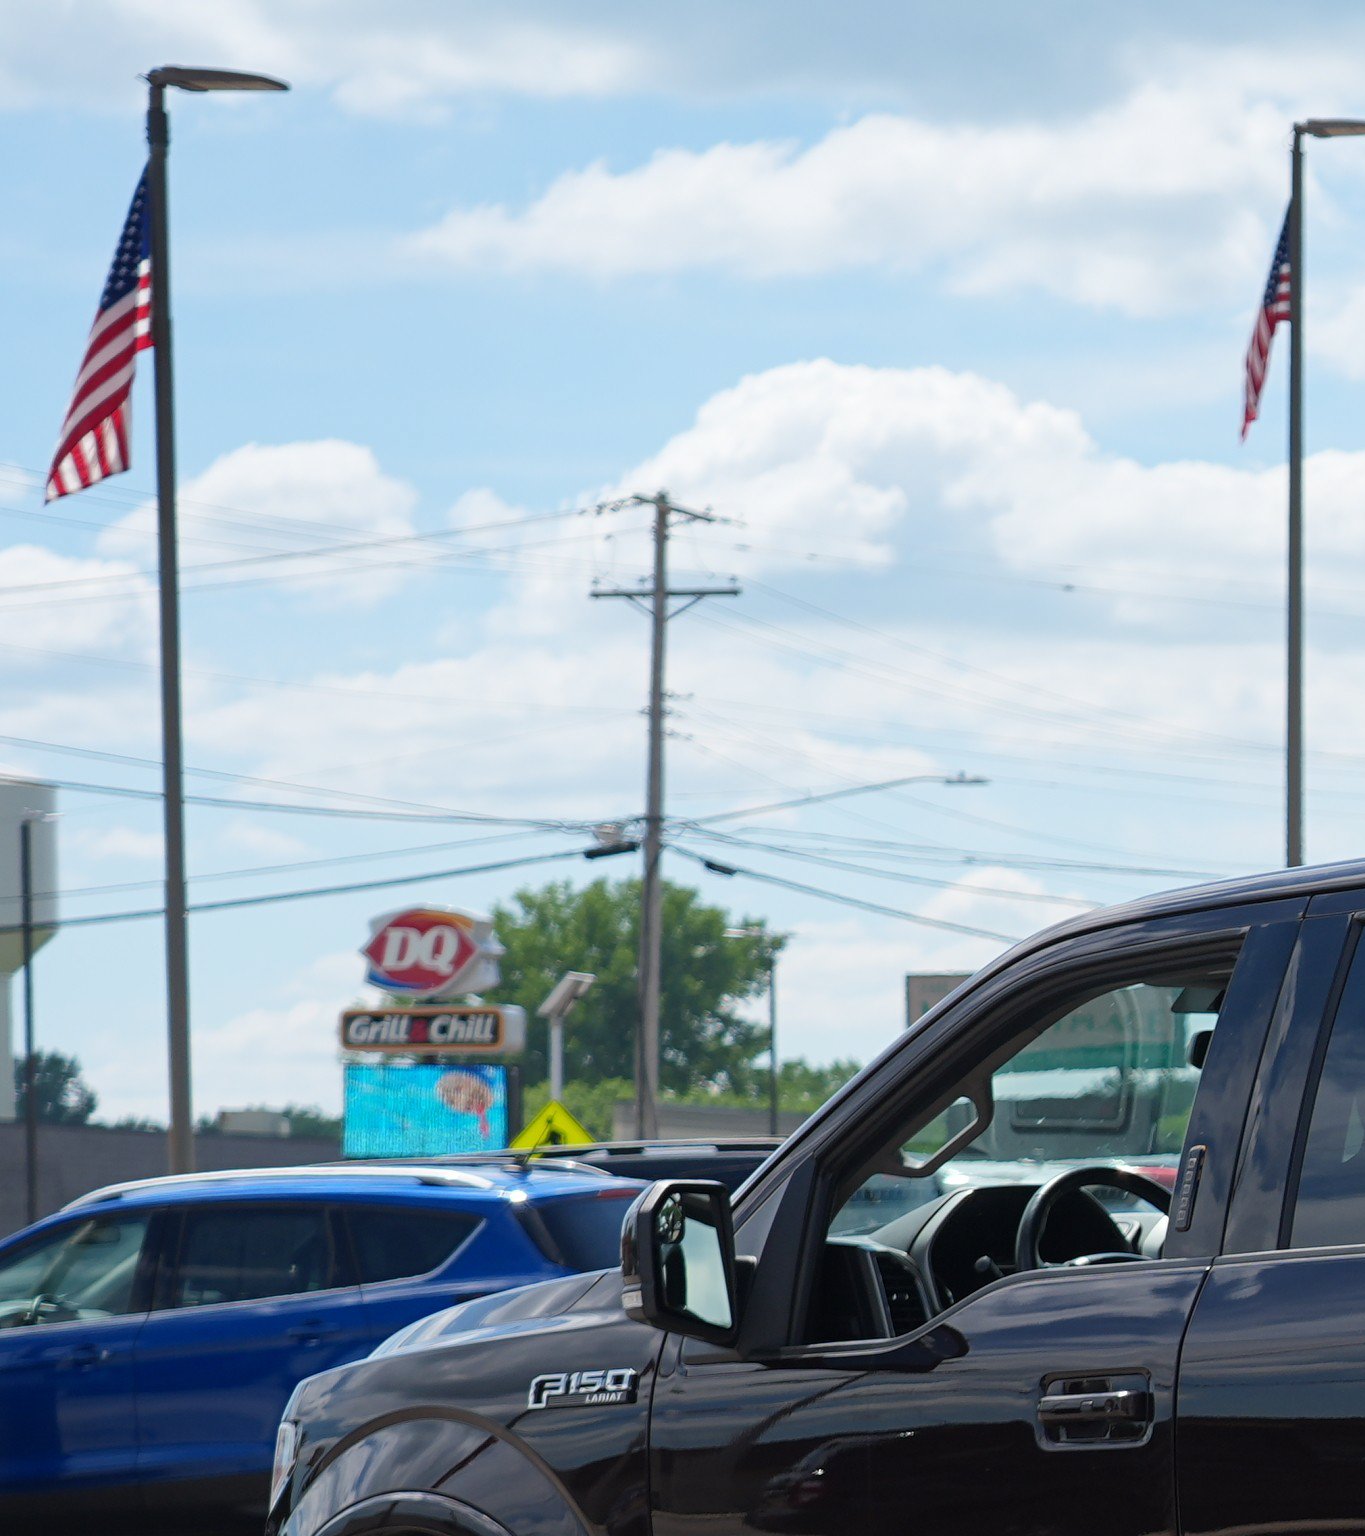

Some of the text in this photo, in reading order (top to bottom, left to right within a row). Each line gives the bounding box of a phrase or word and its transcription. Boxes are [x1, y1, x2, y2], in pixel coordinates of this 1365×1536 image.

[382, 925, 460, 976] DQ
[348, 1015, 411, 1043] Grill
[428, 1014, 496, 1043] Chill
[585, 1391, 624, 1404] LARIAT
